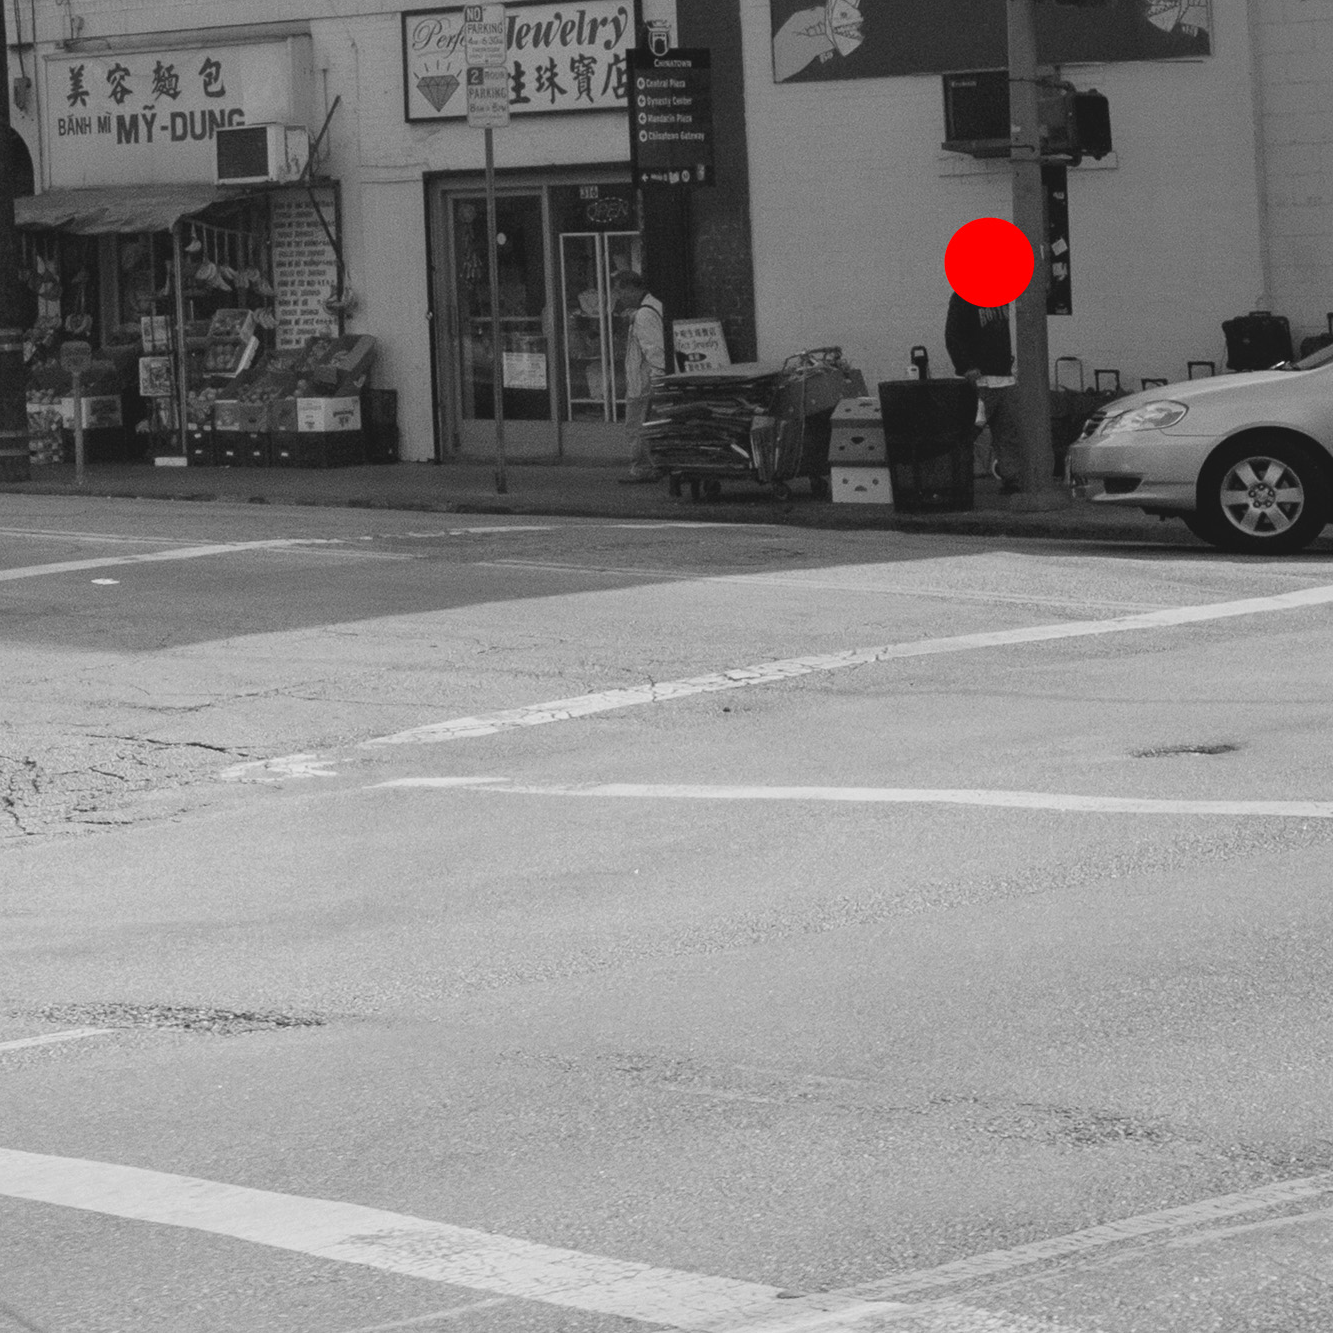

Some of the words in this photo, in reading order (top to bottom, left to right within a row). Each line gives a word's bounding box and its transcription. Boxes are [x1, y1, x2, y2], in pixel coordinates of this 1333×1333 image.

[466, 6, 482, 21] NO
[467, 22, 504, 34] PARKING
[505, 6, 628, 51] Jewelry
[66, 57, 227, 108] 美容麵包
[470, 69, 480, 84] 2
[469, 87, 507, 99] PARKING
